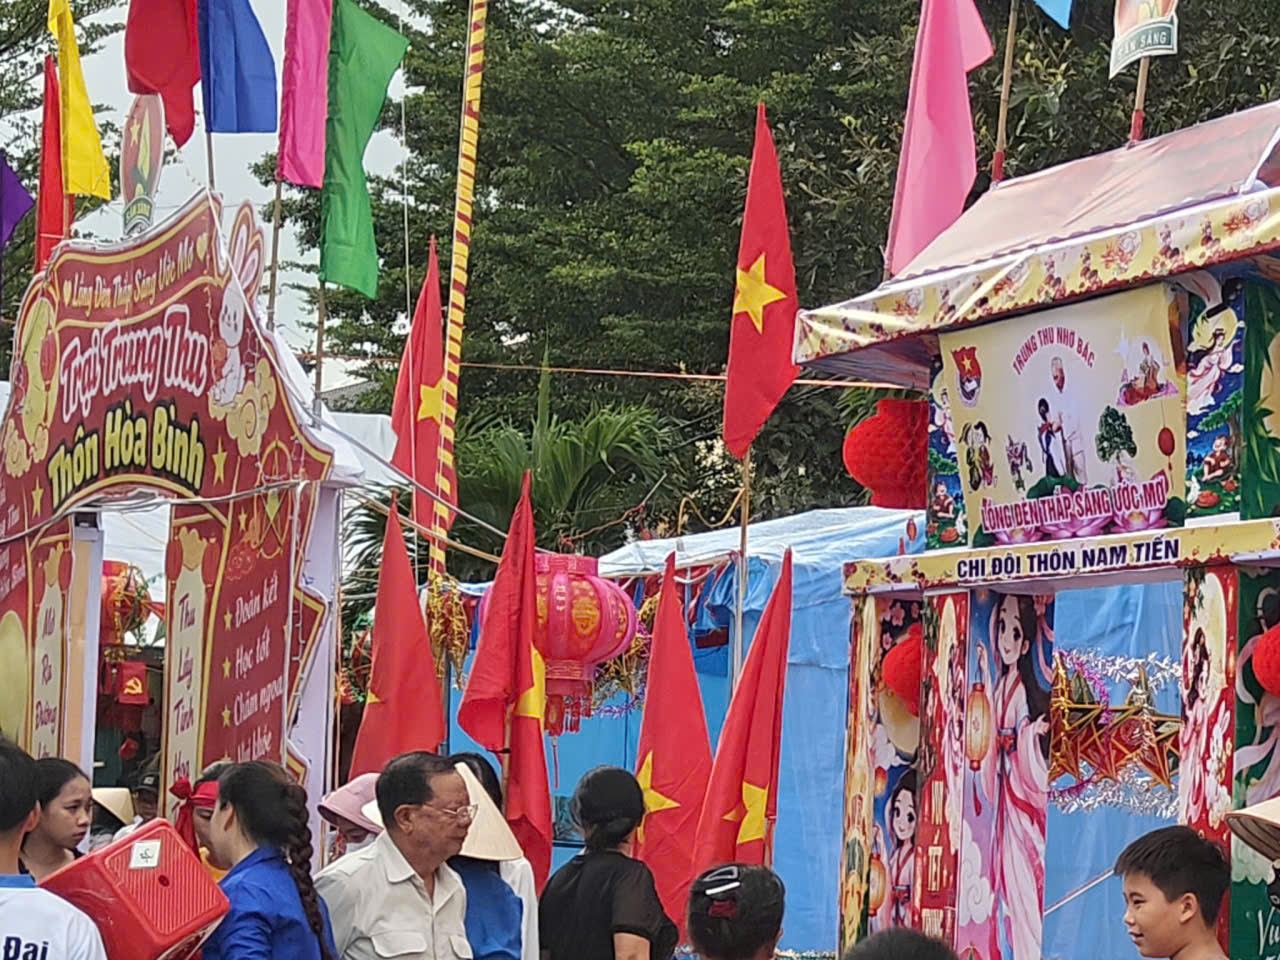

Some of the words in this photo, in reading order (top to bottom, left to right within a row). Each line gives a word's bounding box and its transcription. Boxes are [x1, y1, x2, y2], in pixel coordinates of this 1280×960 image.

[1012, 334, 1038, 375] TRUNG
[1037, 326, 1055, 347] THU
[48, 424, 98, 508] Thôn
[104, 399, 147, 470] Hòa
[151, 403, 205, 491] Bình
[957, 558, 986, 578] CHI
[991, 552, 1021, 579] ĐỘI
[1027, 547, 1075, 573] THÔN
[1082, 545, 1127, 568] NAM
[1133, 533, 1180, 562] TIẾN
